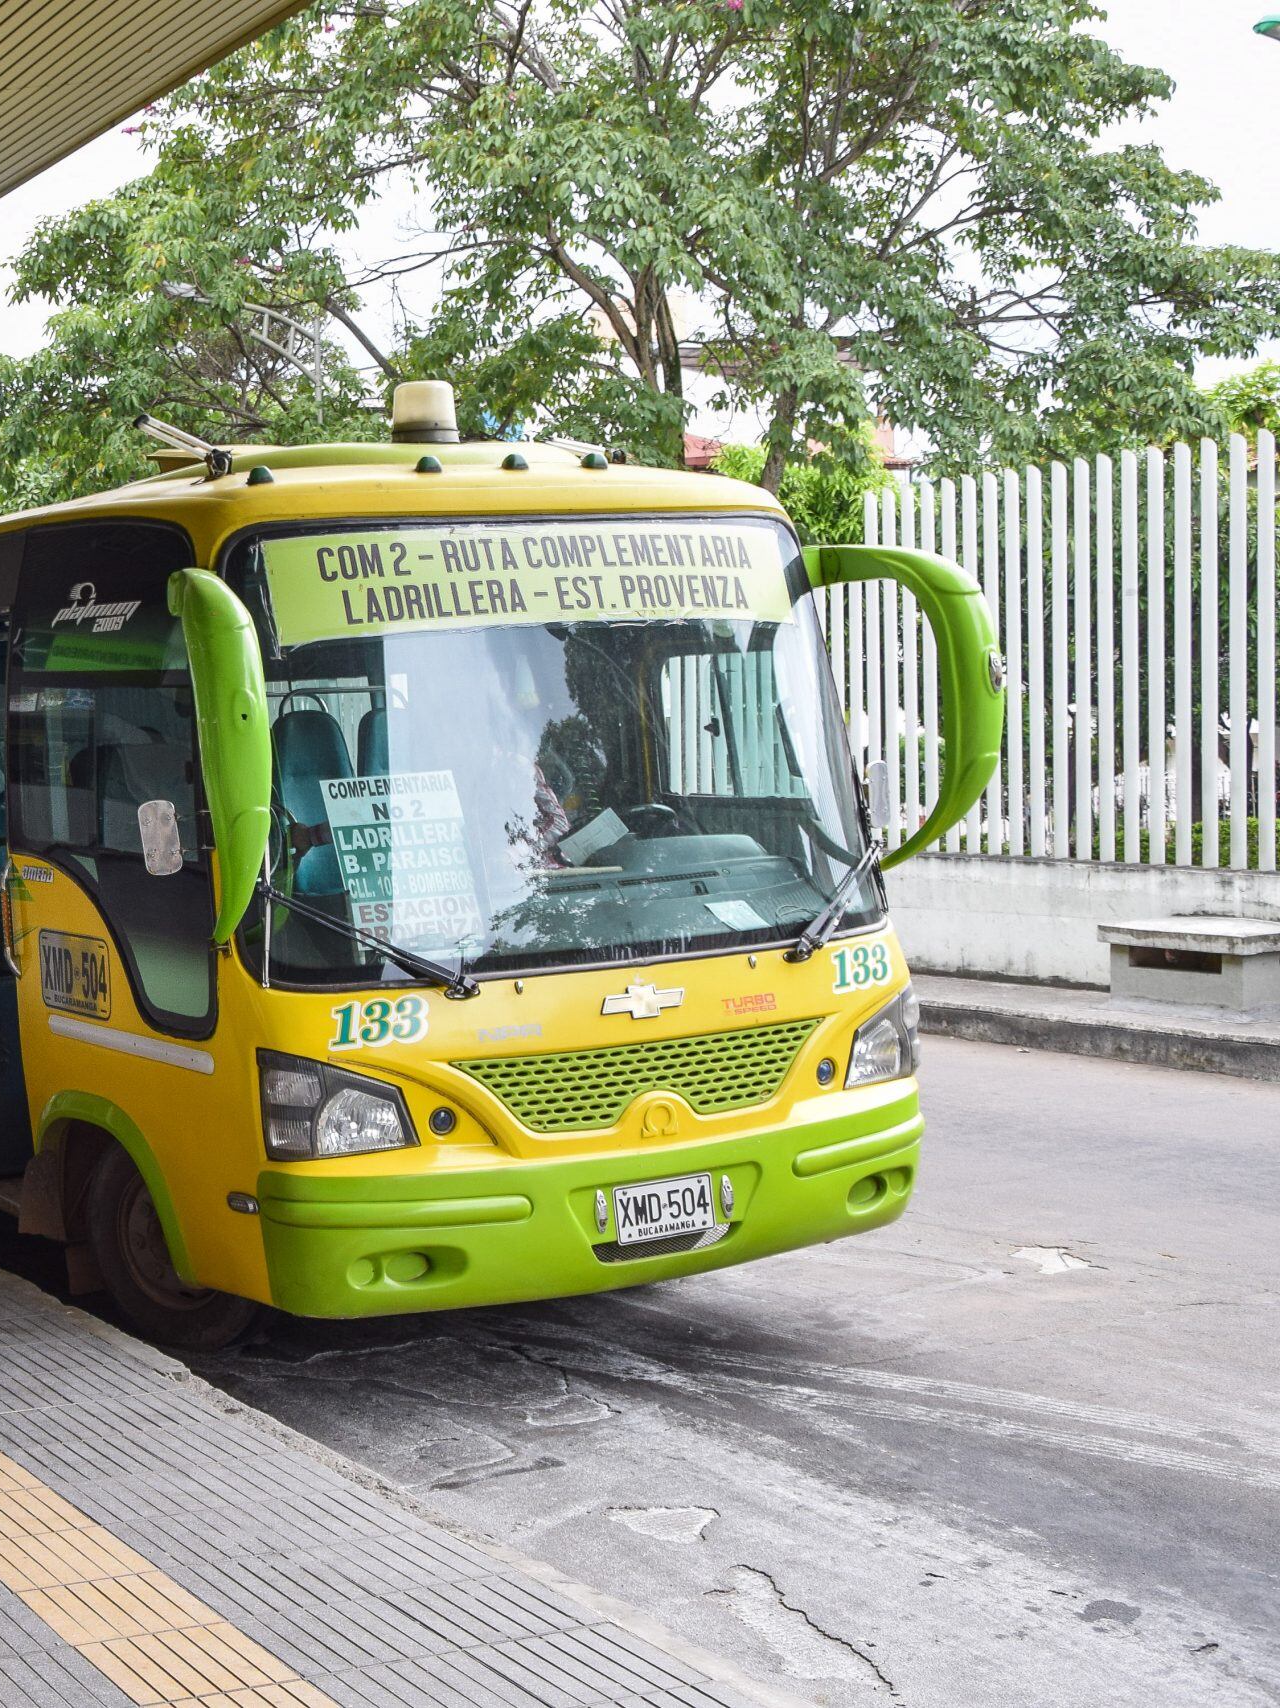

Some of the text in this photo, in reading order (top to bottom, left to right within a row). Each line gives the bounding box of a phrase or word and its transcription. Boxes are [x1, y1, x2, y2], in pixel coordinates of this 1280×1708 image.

[316, 543, 385, 583] COM
[389, 542, 412, 577] 2
[440, 537, 519, 574] RUTA
[522, 534, 752, 569] COMPLEMENTARIA
[341, 578, 528, 625] LADRILLERA
[619, 575, 749, 609] PROVENZA
[92, 616, 124, 632] 2009
[328, 773, 454, 800] COMPLEMENTARIA
[411, 800, 426, 818] 2
[337, 822, 464, 851] LADRILLERA
[342, 846, 468, 874] B. PARAISO
[359, 896, 476, 924] ESTACION
[832, 943, 890, 992] 133
[54, 994, 98, 1012] BUCARAMANGA
[721, 993, 775, 1009] TURBO
[330, 996, 426, 1048] 133
[638, 1219, 696, 1238] BUCARAMANGA
